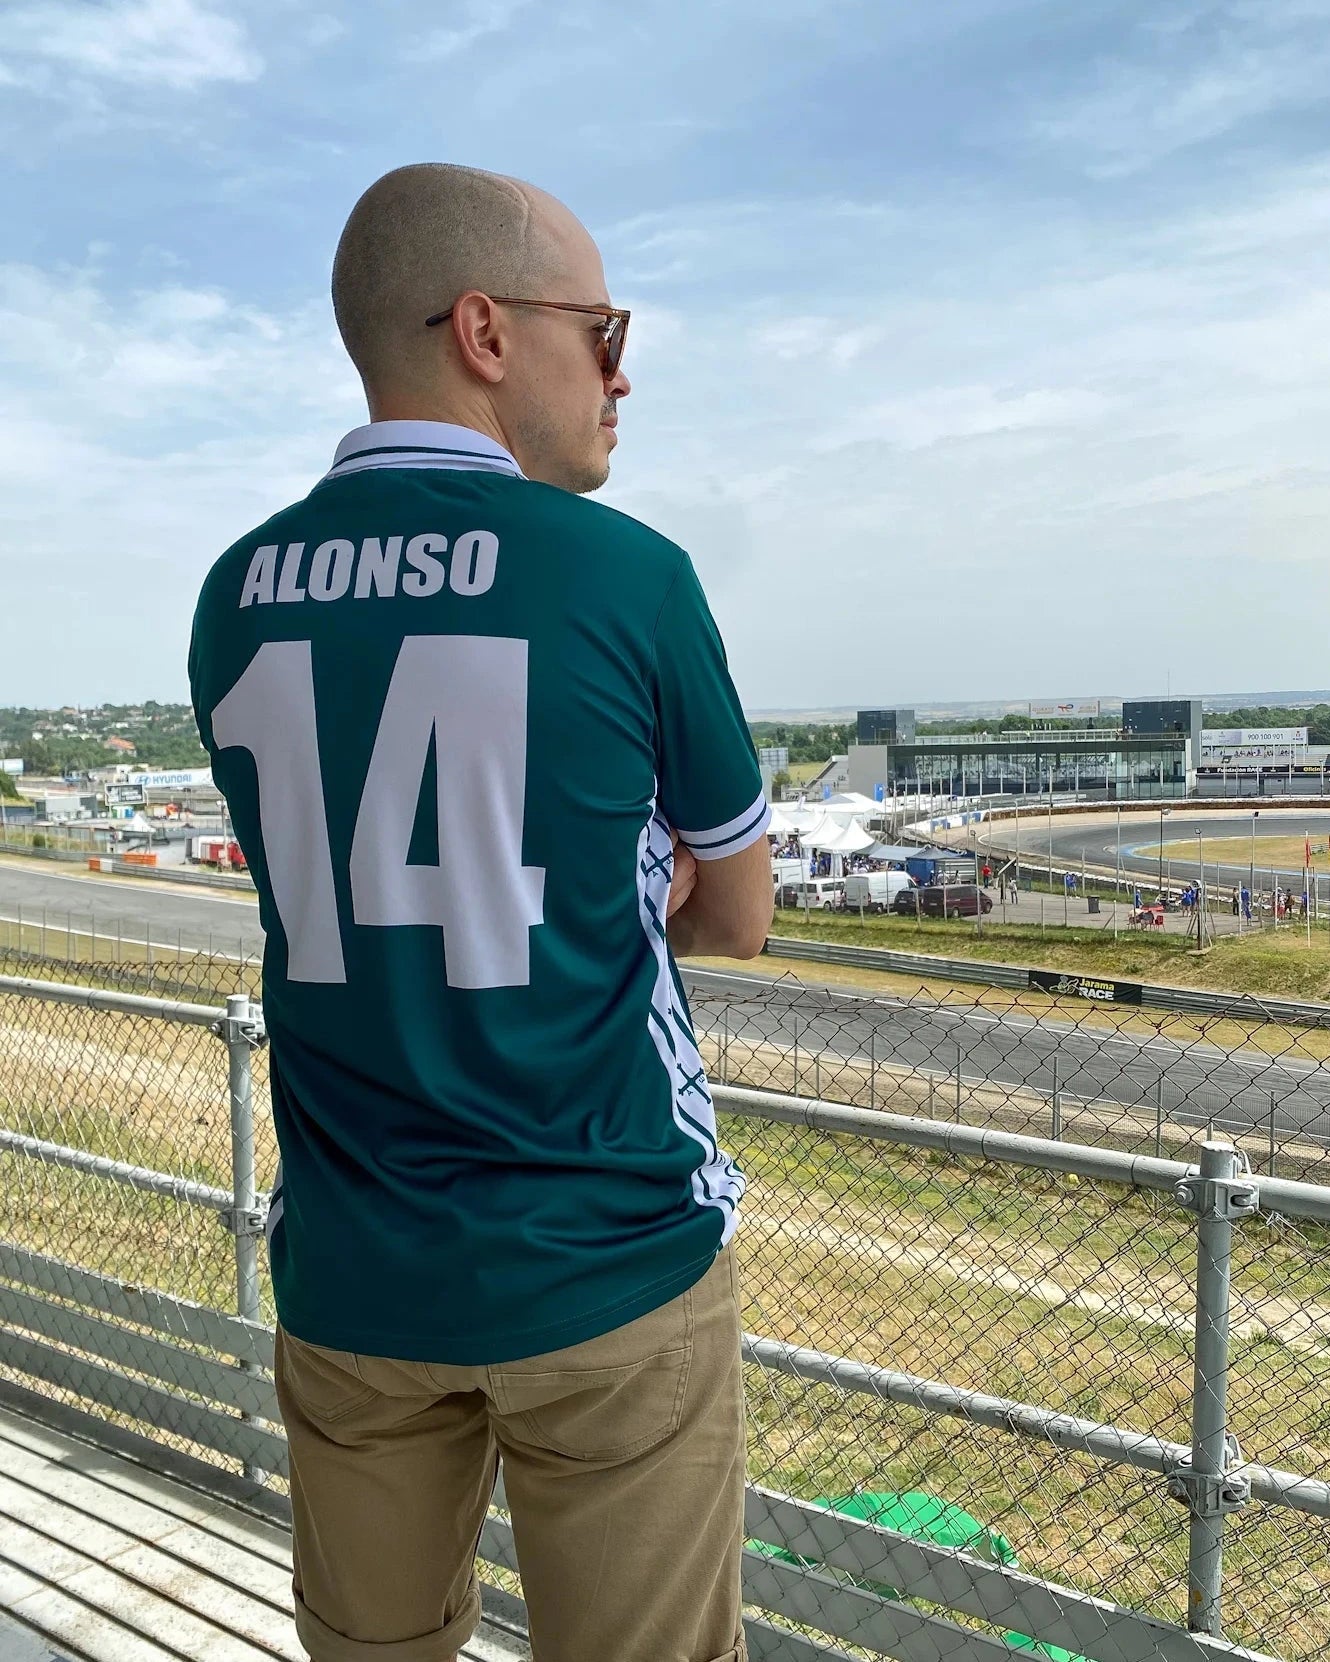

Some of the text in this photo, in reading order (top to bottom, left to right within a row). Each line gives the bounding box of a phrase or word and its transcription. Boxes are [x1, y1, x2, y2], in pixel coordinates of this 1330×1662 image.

[238, 529, 499, 609] ALONSO
[152, 774, 192, 784] HYUNDAI
[211, 634, 546, 989] 14
[1079, 978, 1115, 991] Jarama
[1078, 986, 1114, 1001] RACE
